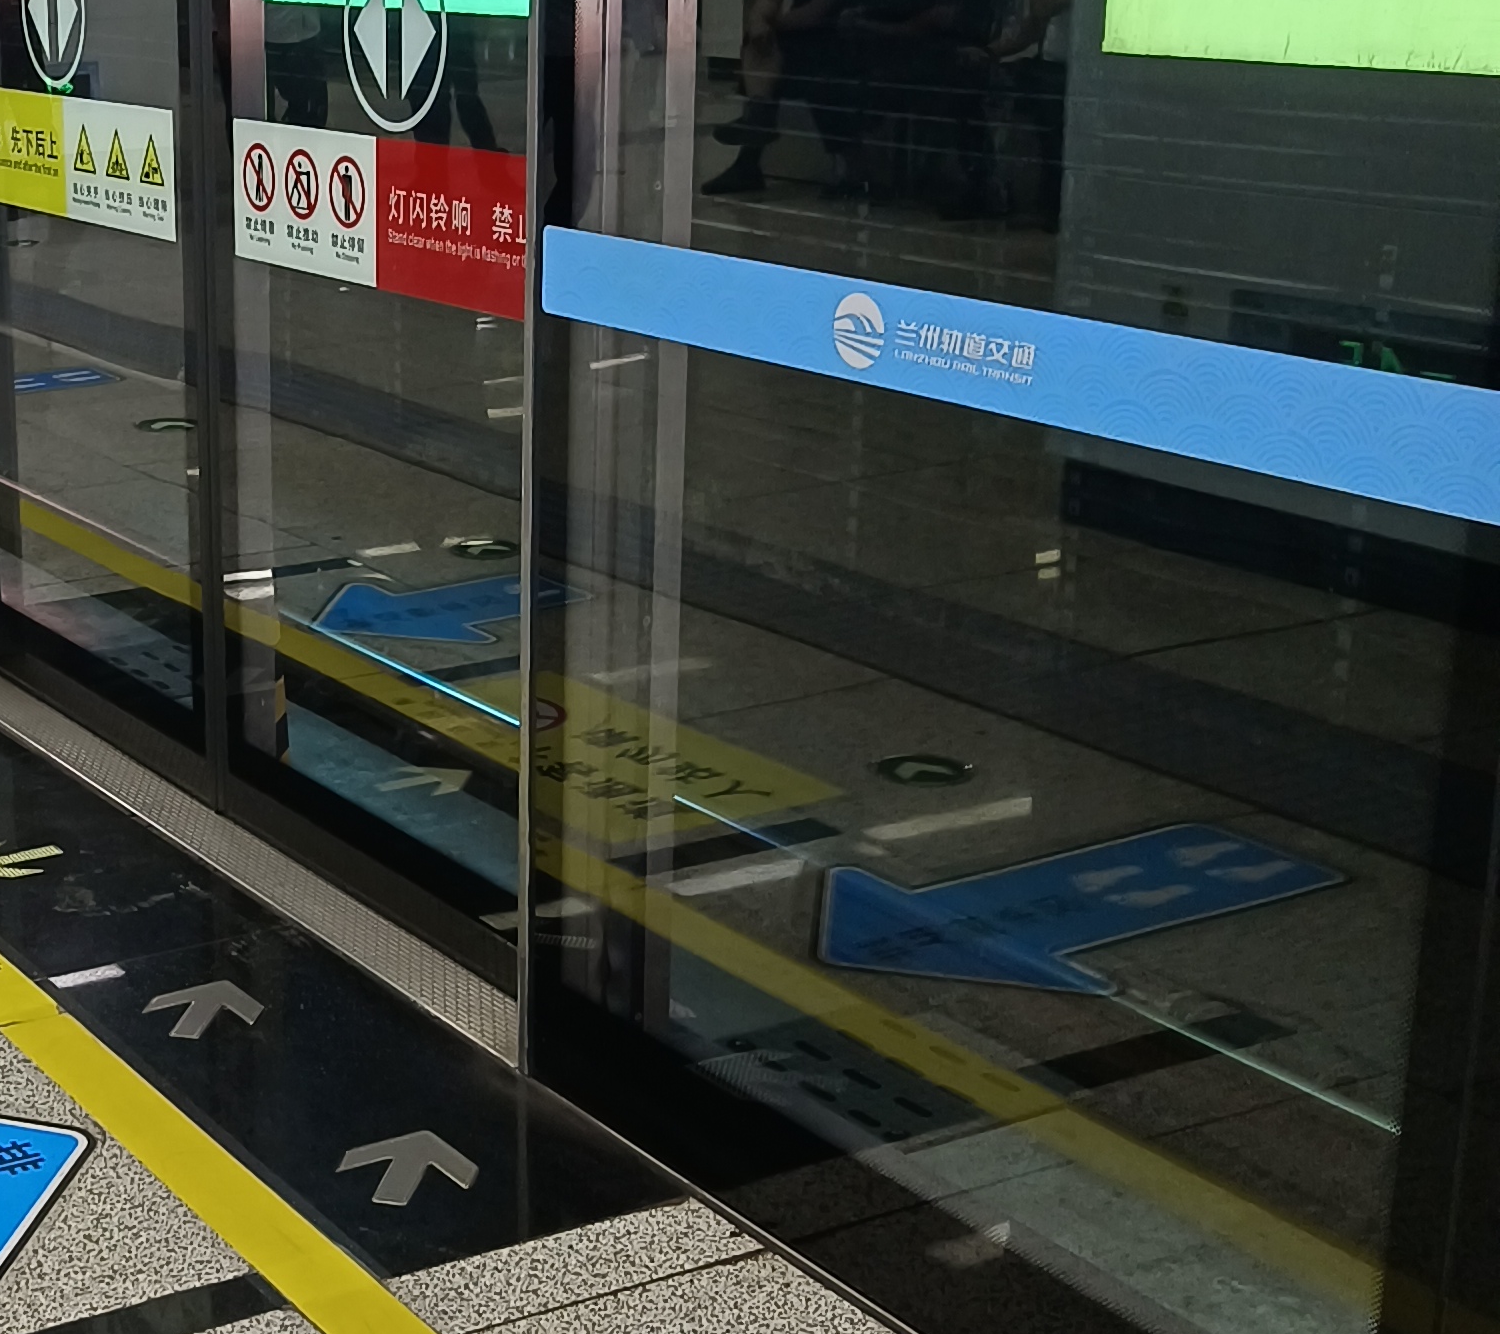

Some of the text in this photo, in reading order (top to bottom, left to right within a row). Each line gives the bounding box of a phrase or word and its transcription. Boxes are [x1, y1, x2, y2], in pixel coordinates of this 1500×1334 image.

[11, 126, 59, 160] 先下后上
[388, 185, 471, 236] 灯闪铃响
[388, 228, 407, 246] Stand
[894, 319, 1036, 370] 兰州轨道交通
